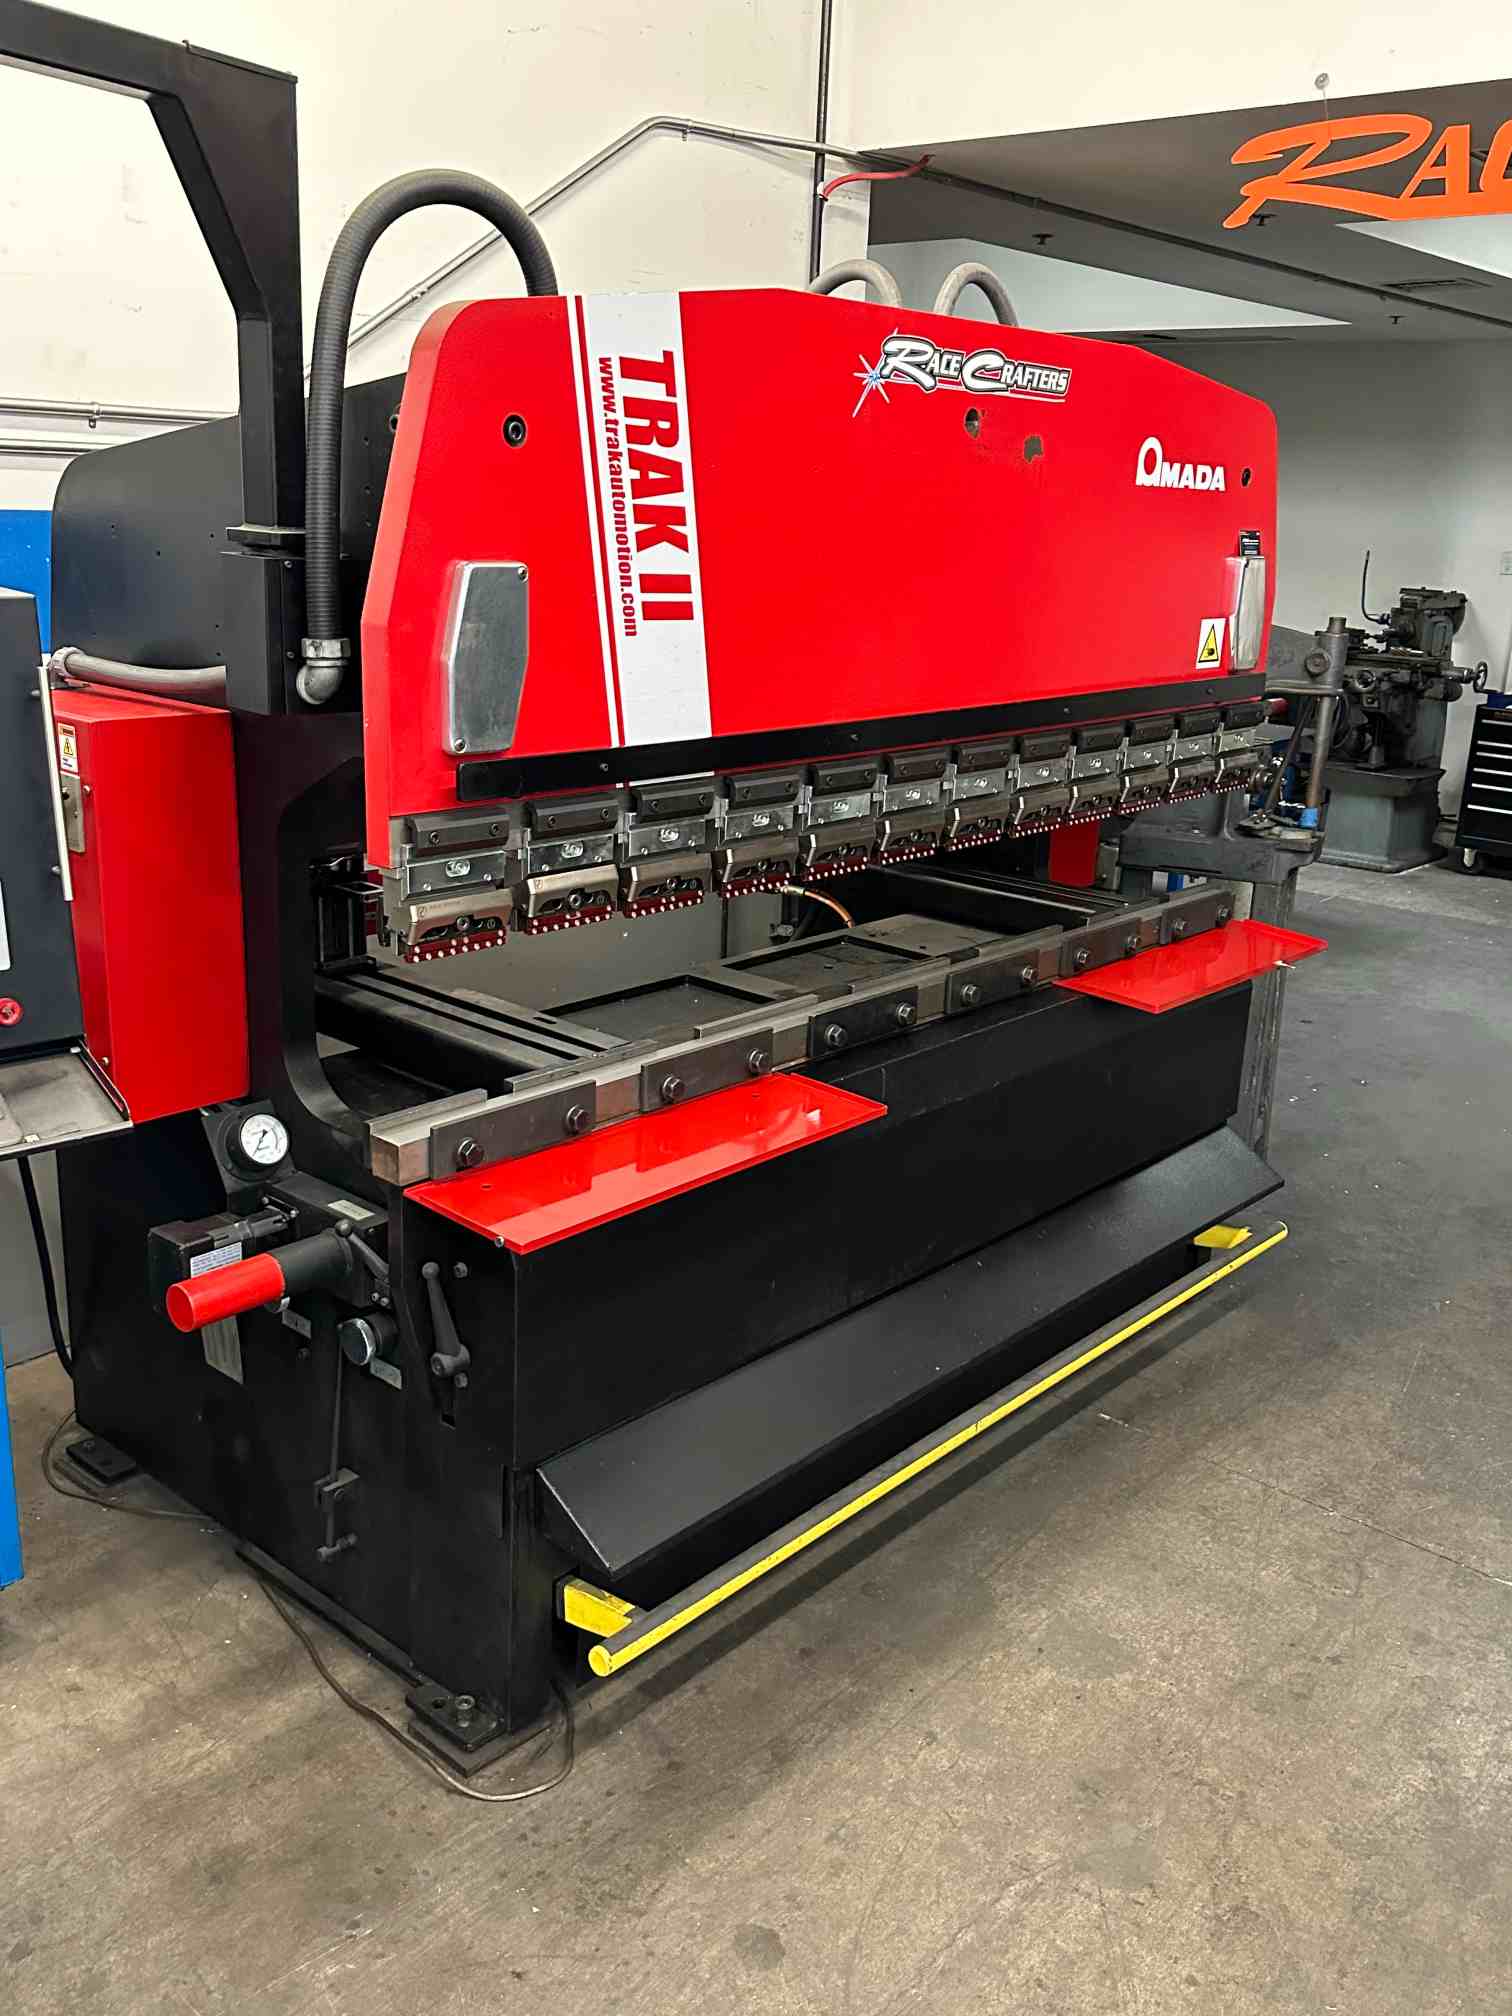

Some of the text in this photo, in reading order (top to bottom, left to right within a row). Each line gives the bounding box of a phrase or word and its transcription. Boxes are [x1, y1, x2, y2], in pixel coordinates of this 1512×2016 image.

[882, 336, 1070, 393] RACE CRAFTERS
[599, 356, 638, 637] www.trakautomotion.com
[619, 350, 694, 621] TRAK II
[1136, 437, 1226, 491] AMADA
